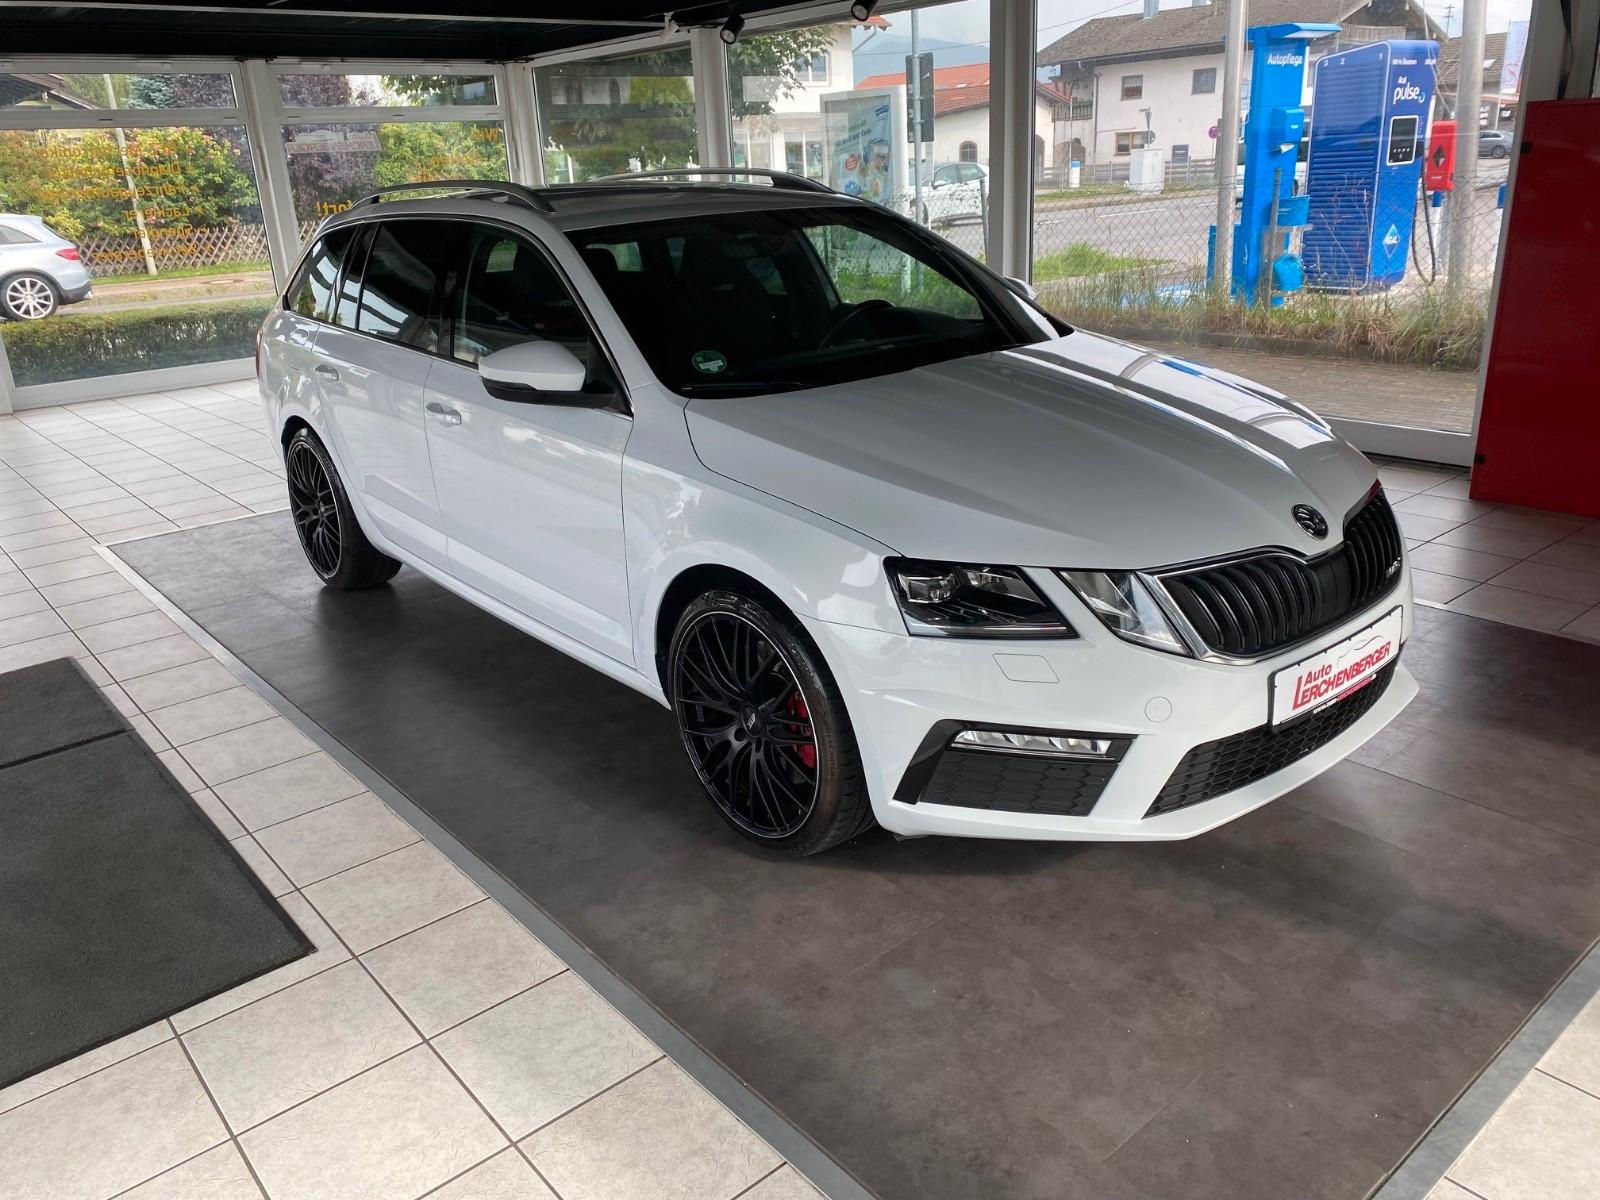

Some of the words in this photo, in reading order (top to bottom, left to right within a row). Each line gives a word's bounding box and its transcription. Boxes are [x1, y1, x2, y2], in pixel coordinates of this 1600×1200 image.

[1267, 53, 1303, 66] Autopflege
[1393, 82, 1420, 104] pulse
[1292, 640, 1392, 711] LERCHENBERGER
[1304, 663, 1333, 687] Auto
